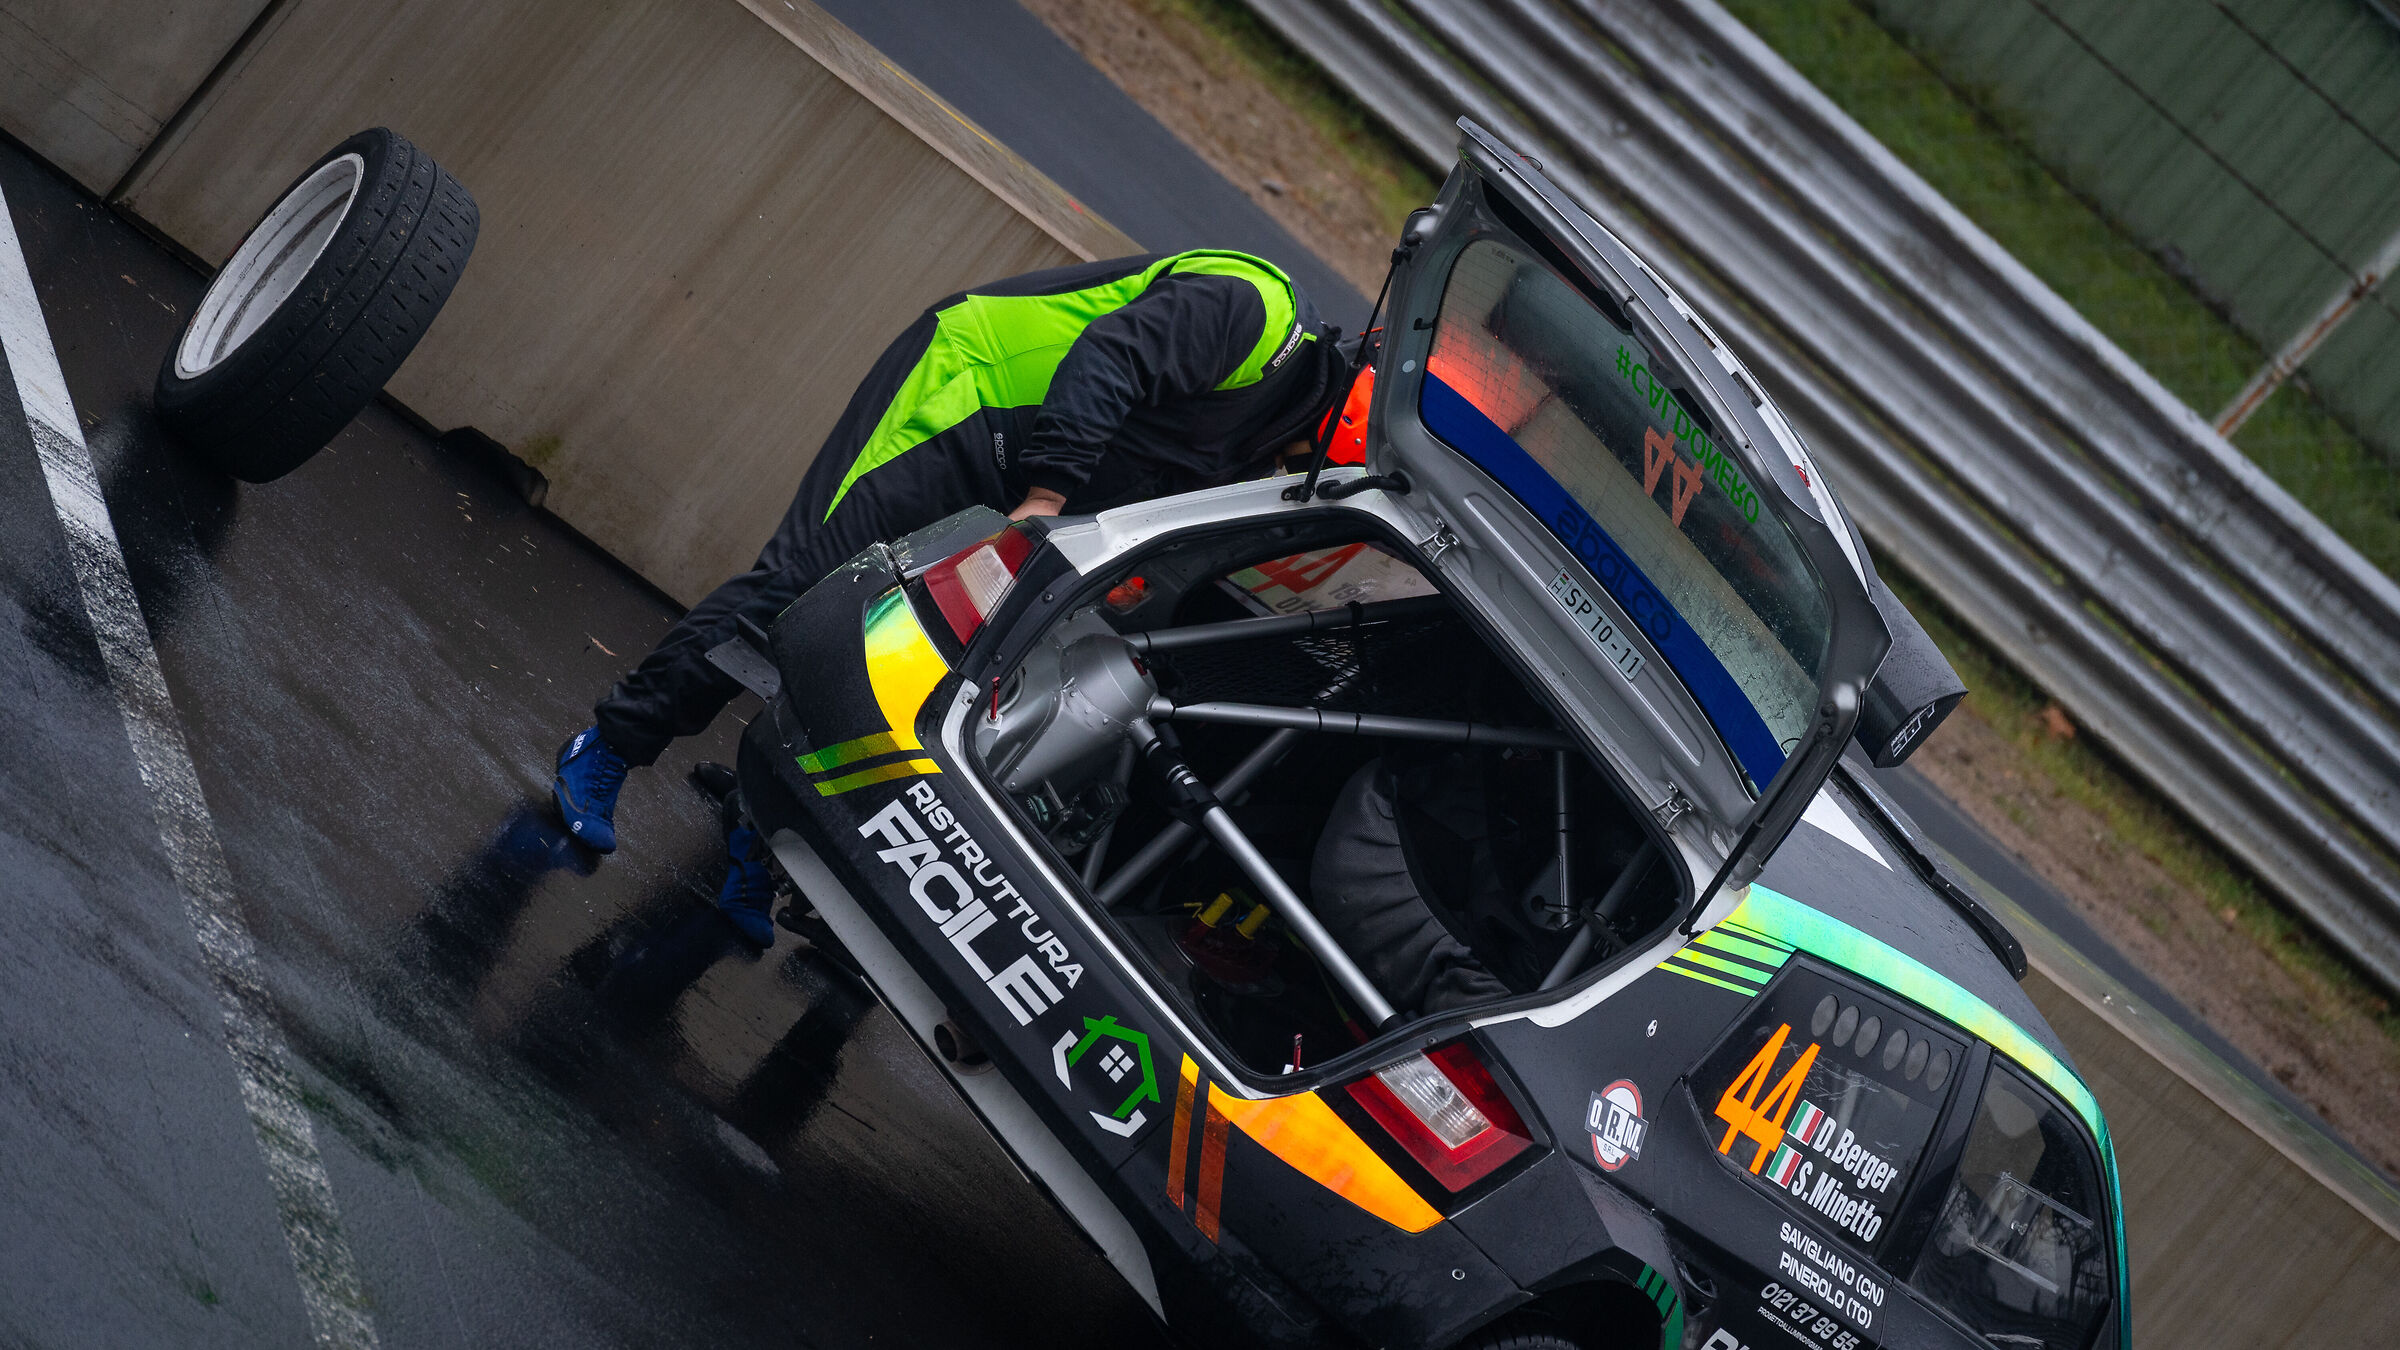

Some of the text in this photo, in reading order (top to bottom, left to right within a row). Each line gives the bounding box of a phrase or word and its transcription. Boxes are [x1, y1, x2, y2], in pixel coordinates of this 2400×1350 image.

[1564, 588, 1592, 615] SP
[857, 799, 1065, 1027] FACILE
[905, 780, 1085, 989] RISTRUTTURA
[1714, 1022, 1822, 1176] 44
[1812, 1116, 1898, 1193] D.Berger
[1791, 1161, 1882, 1243] S.Minetto
[1780, 1222, 1885, 1307] SAVIGLIANO (CN)
[1780, 1251, 1873, 1329] PINEROLO (TO)
[1760, 1282, 1860, 1350] 0121 37 99 55
